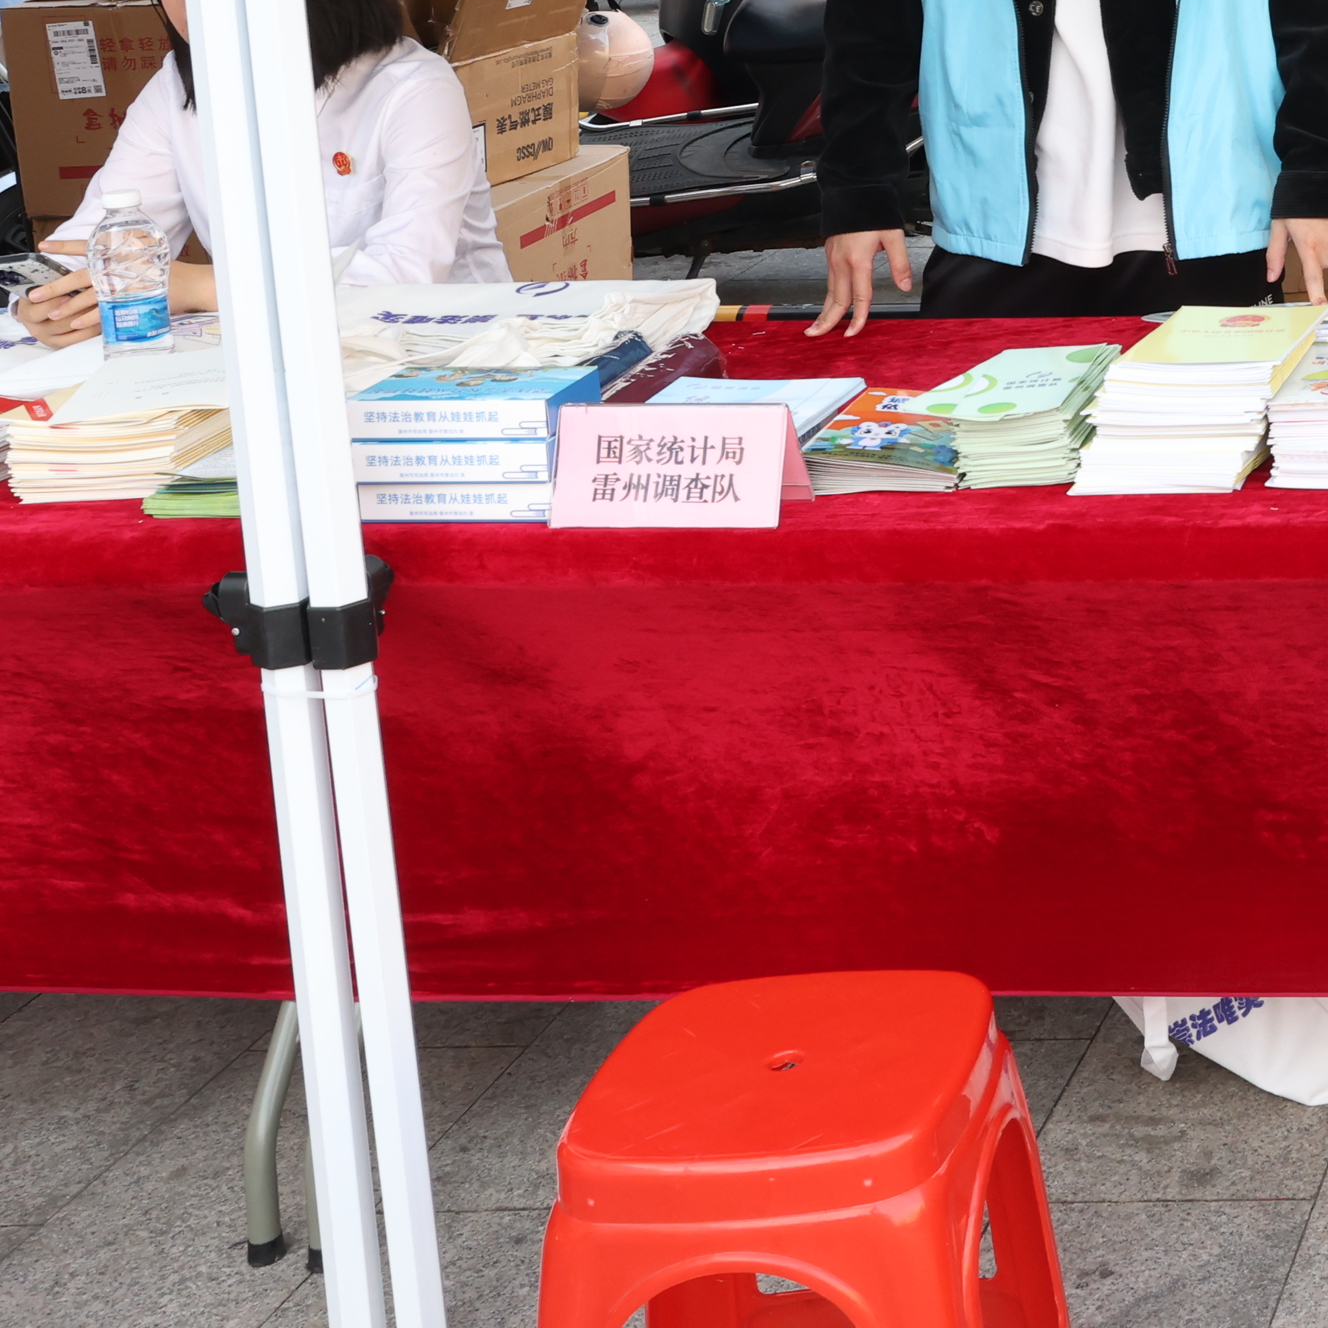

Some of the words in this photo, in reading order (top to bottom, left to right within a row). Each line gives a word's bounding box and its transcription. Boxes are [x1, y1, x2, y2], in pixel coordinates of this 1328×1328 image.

[100, 36, 173, 53] 轻拿轻放
[102, 56, 165, 71] 请勿踩
[520, 79, 541, 93] METER
[541, 77, 554, 88] GAS
[510, 86, 554, 108] DIAPHRAGM
[495, 102, 554, 136] 膜式燃气表
[363, 411, 499, 423] 坚持法治教育从娃娃抓起
[596, 434, 746, 467] 国家统计局
[365, 454, 500, 467] 坚持法治教育从娃娃抓起
[590, 472, 742, 505] 雷州调查队
[376, 493, 508, 505] 坚持法治教育从娃娃抓起
